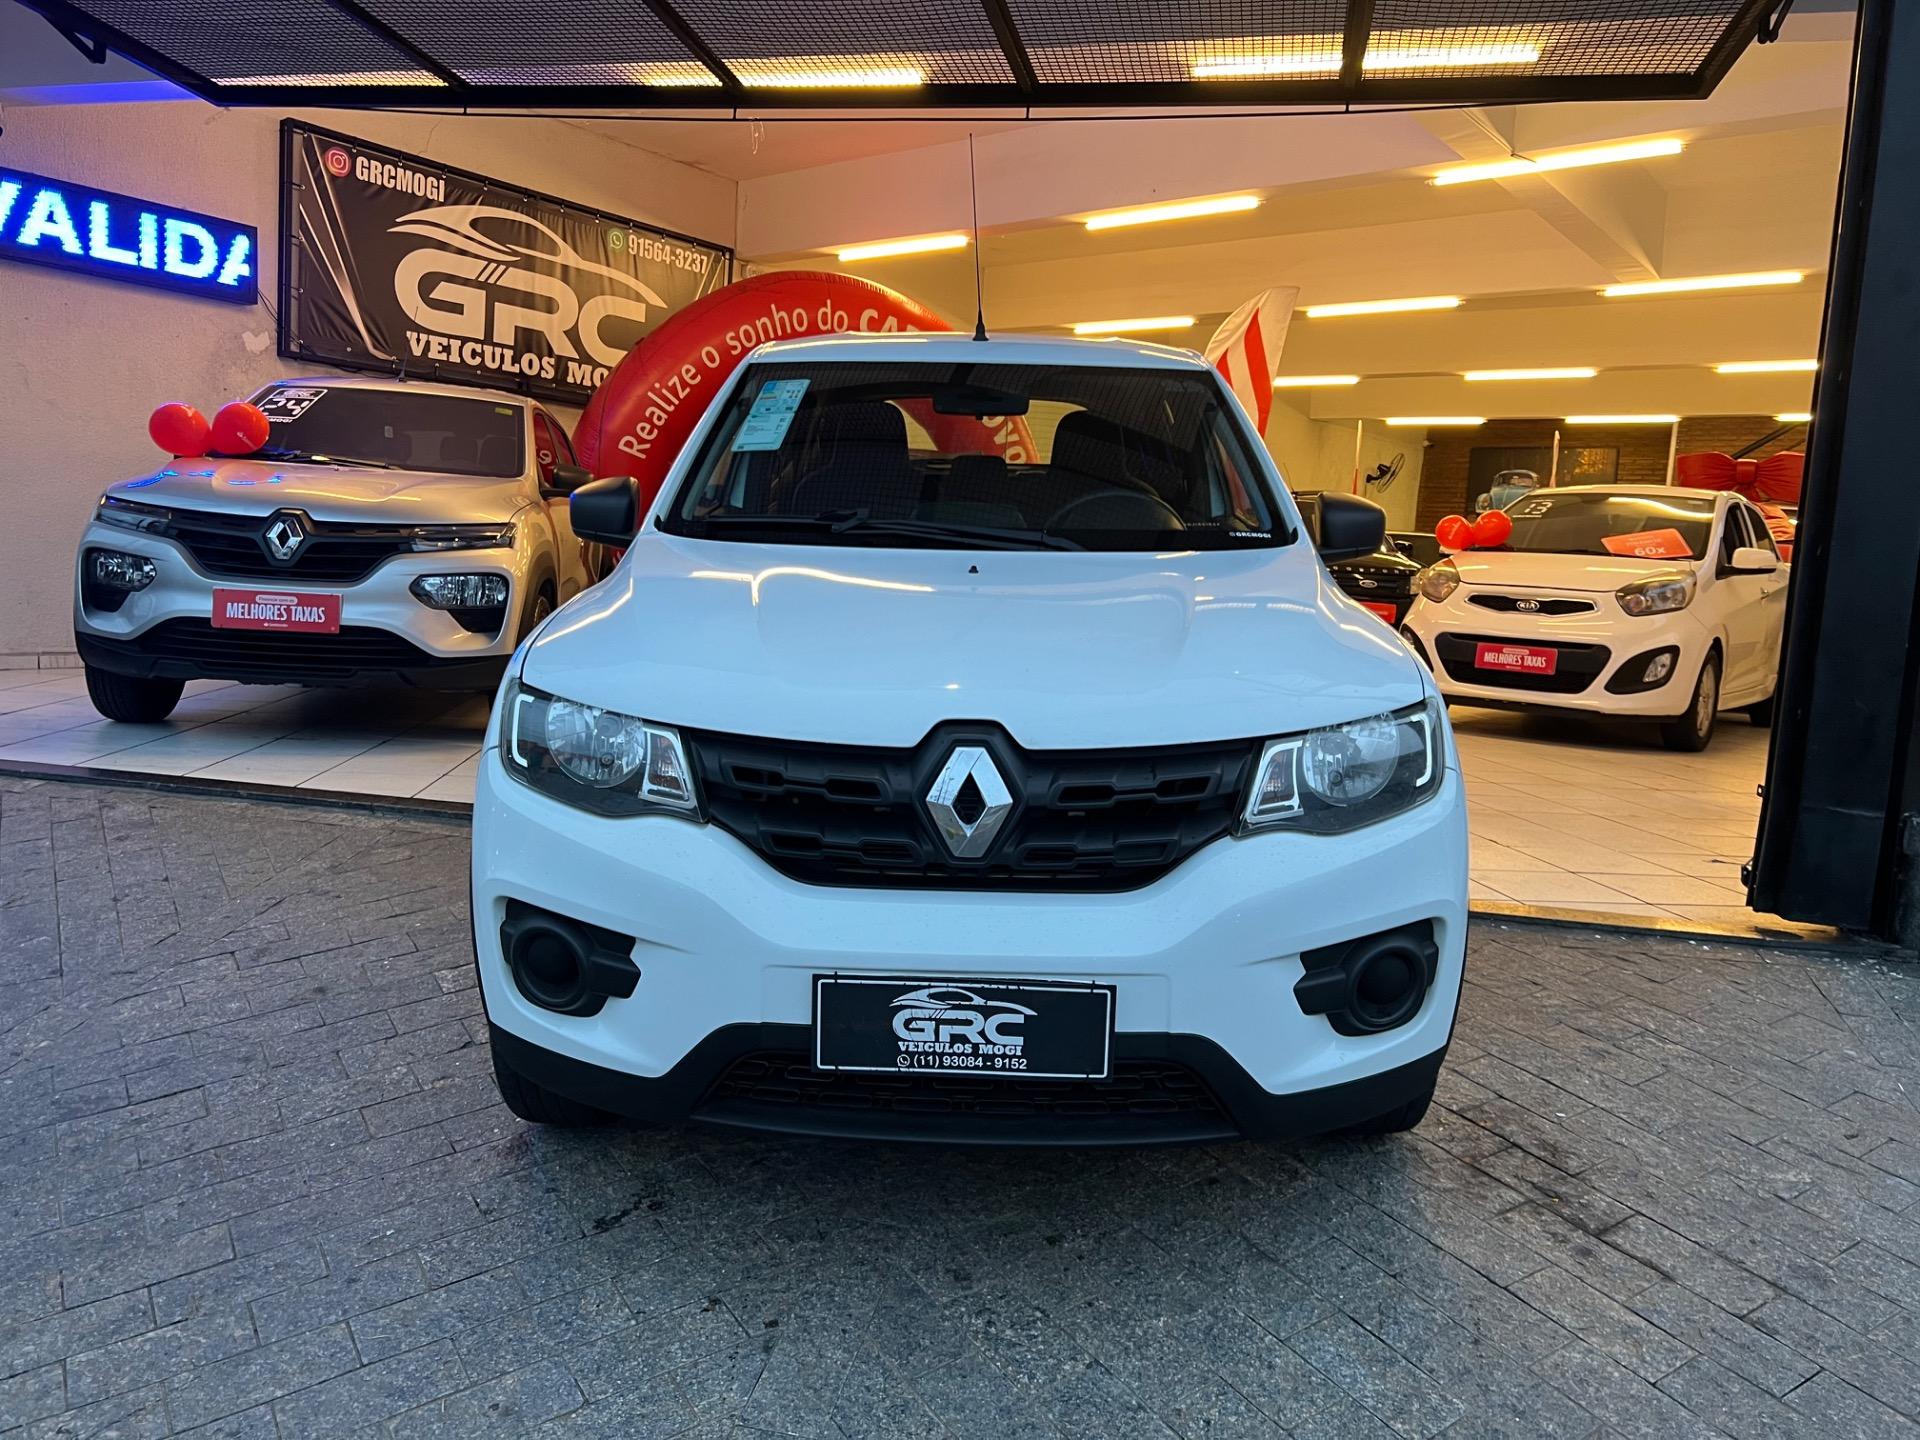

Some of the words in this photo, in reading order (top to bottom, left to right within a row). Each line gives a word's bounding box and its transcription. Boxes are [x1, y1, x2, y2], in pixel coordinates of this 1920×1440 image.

[355, 156, 445, 203] GRCMOGI
[628, 234, 708, 275] 91564-3237
[394, 248, 646, 367] GRC
[406, 331, 556, 379] VEICULOS
[567, 361, 609, 387] MO
[618, 363, 702, 460] Realize
[701, 345, 720, 369] o
[725, 303, 808, 356] sonho
[817, 299, 849, 333] do
[226, 602, 288, 621] MELHORES
[290, 606, 326, 623] TAXAS
[1483, 651, 1522, 666] MELHORES
[1523, 655, 1547, 668] TAXAS
[892, 1008, 1025, 1046] GRC
[898, 1041, 973, 1054] VEICULOS
[978, 1044, 1023, 1056] MOGI
[913, 1055, 940, 1068] (11)
